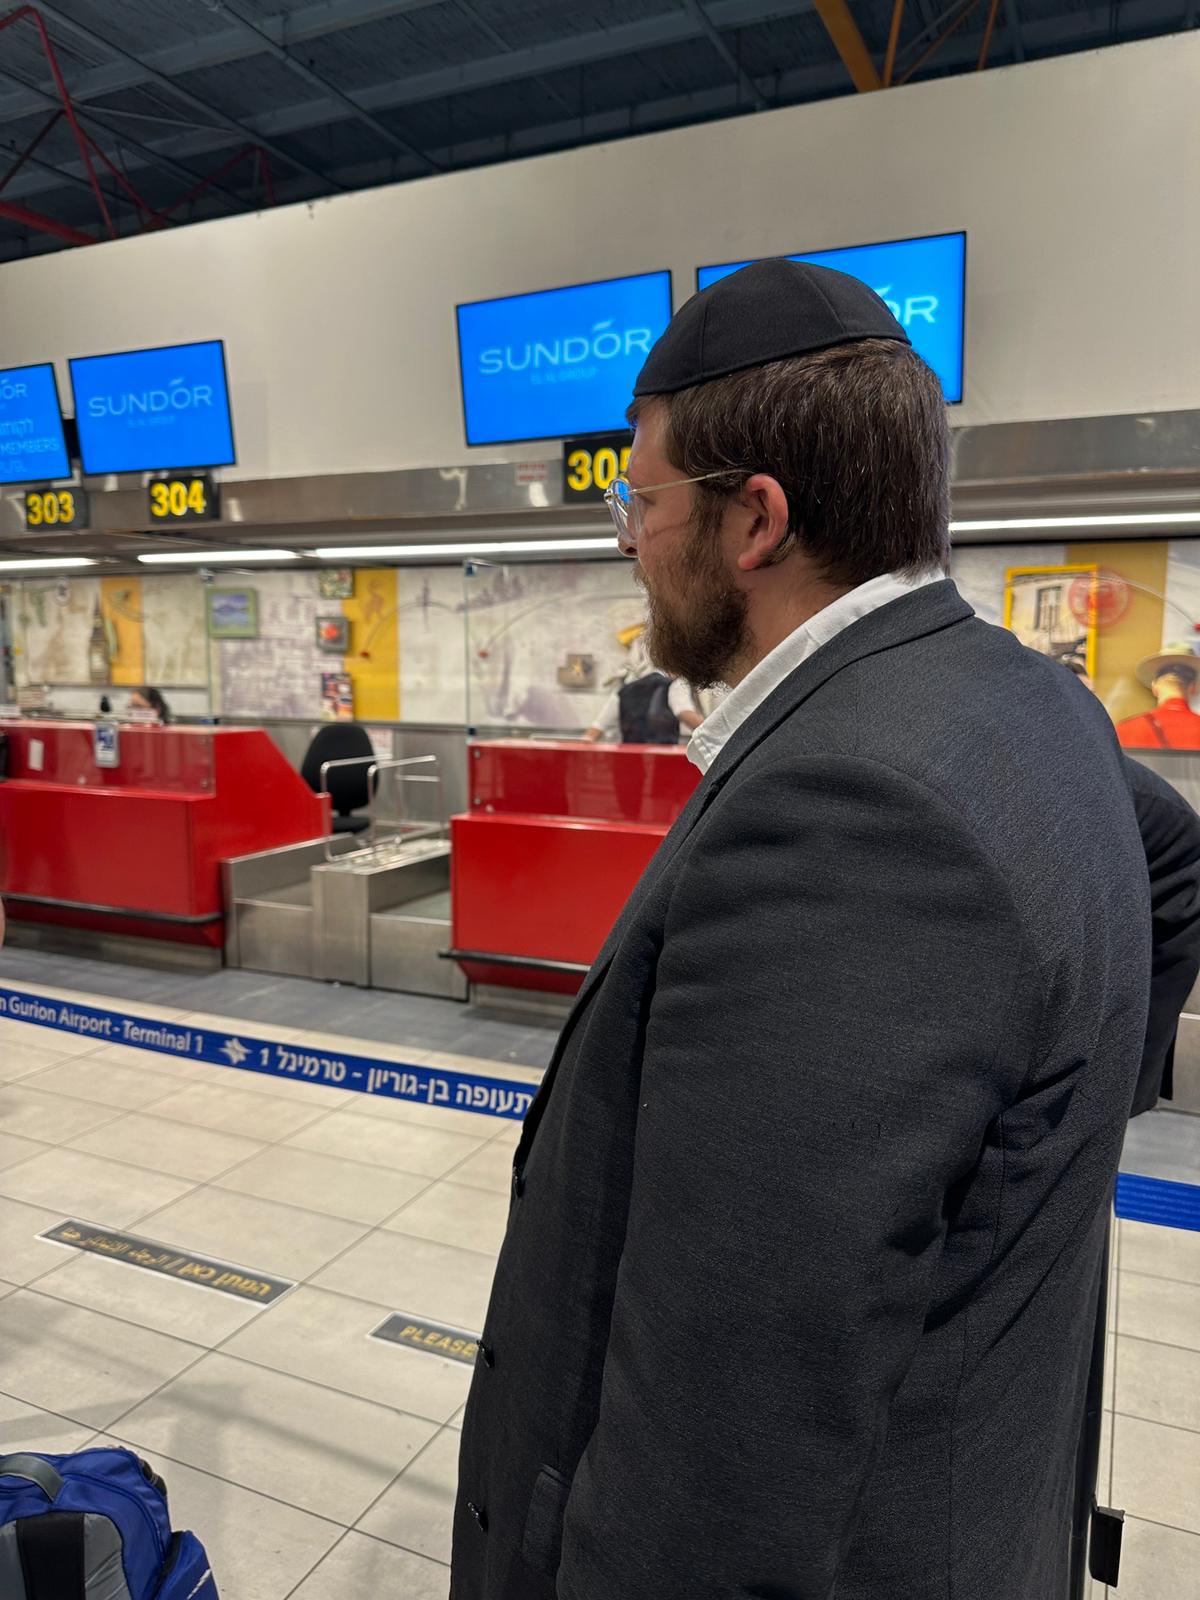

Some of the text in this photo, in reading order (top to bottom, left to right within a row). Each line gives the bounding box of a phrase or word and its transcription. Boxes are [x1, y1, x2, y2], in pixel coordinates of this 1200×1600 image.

[27, 490, 75, 525] 303
[151, 480, 207, 517] 304
[9, 996, 56, 1022] Gurion
[58, 1006, 112, 1035] Airport
[122, 1020, 190, 1051] Terminal
[194, 1034, 203, 1053] 1
[259, 1047, 269, 1066] 1
[276, 1045, 347, 1082] טרמינל
[366, 1067, 450, 1103] בן-גוריון
[399, 1325, 478, 1358] PLEASE
